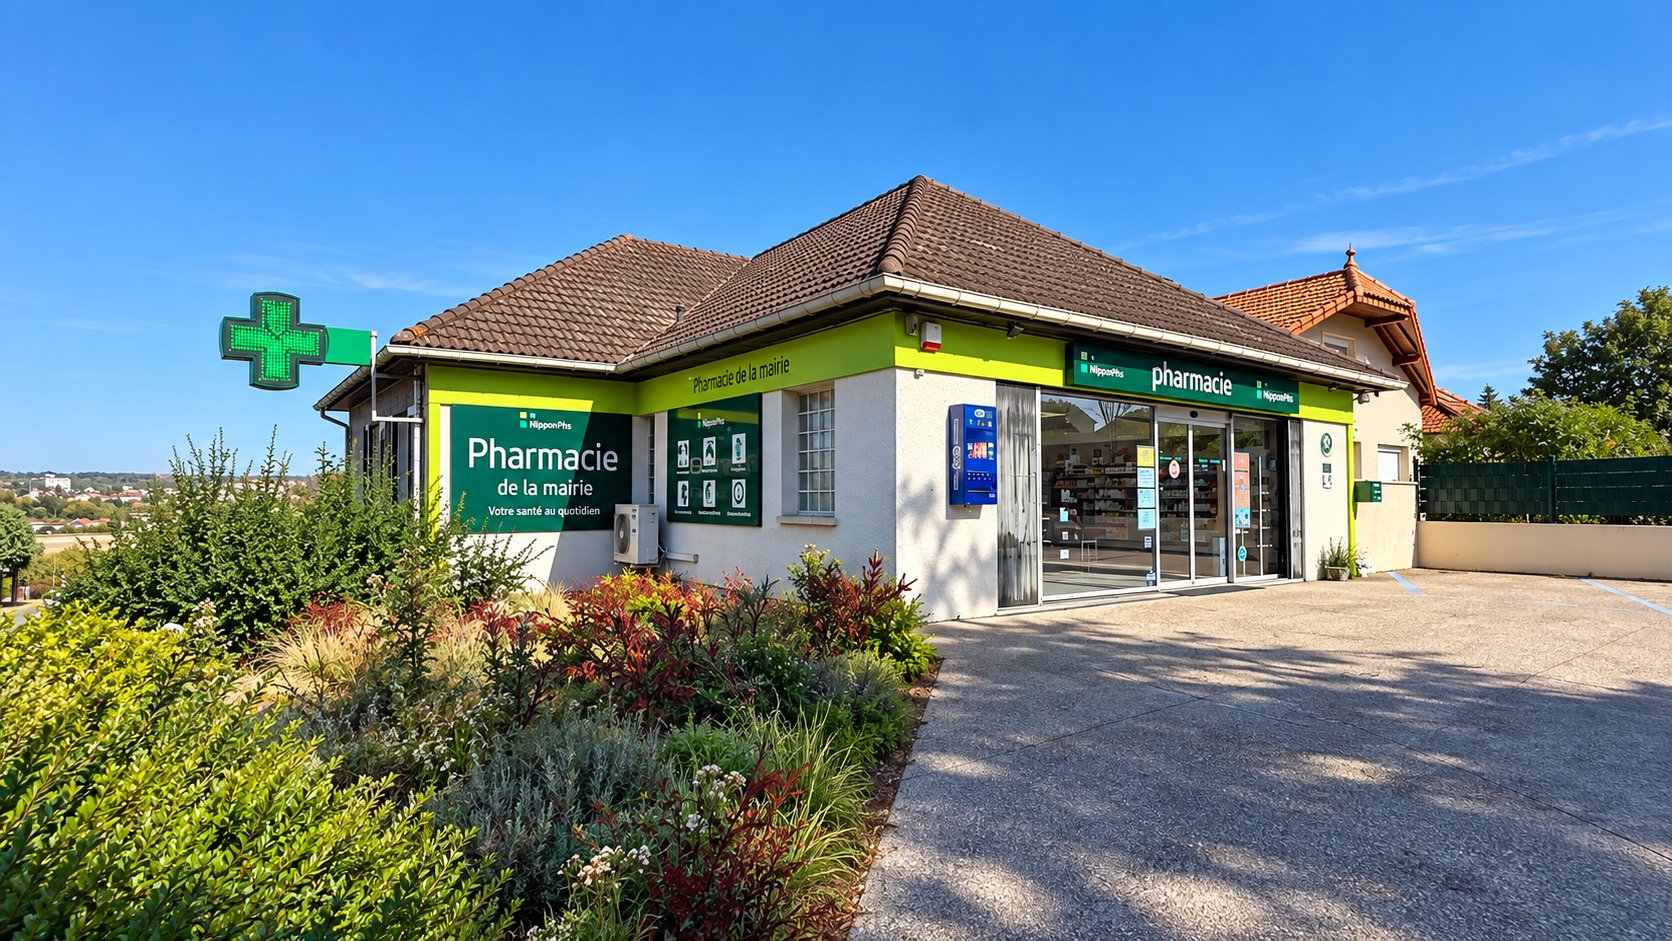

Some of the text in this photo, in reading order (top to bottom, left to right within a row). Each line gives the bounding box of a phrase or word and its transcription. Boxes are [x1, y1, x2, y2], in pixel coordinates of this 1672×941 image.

[693, 355, 790, 394] Pharmacie de la mairie
[1152, 361, 1233, 396] pharmacie
[529, 420, 572, 430] NipponPhs
[468, 437, 619, 471] Pharmacie
[497, 478, 593, 496] de la mairie
[488, 505, 600, 518] Votre santé au quotidien
